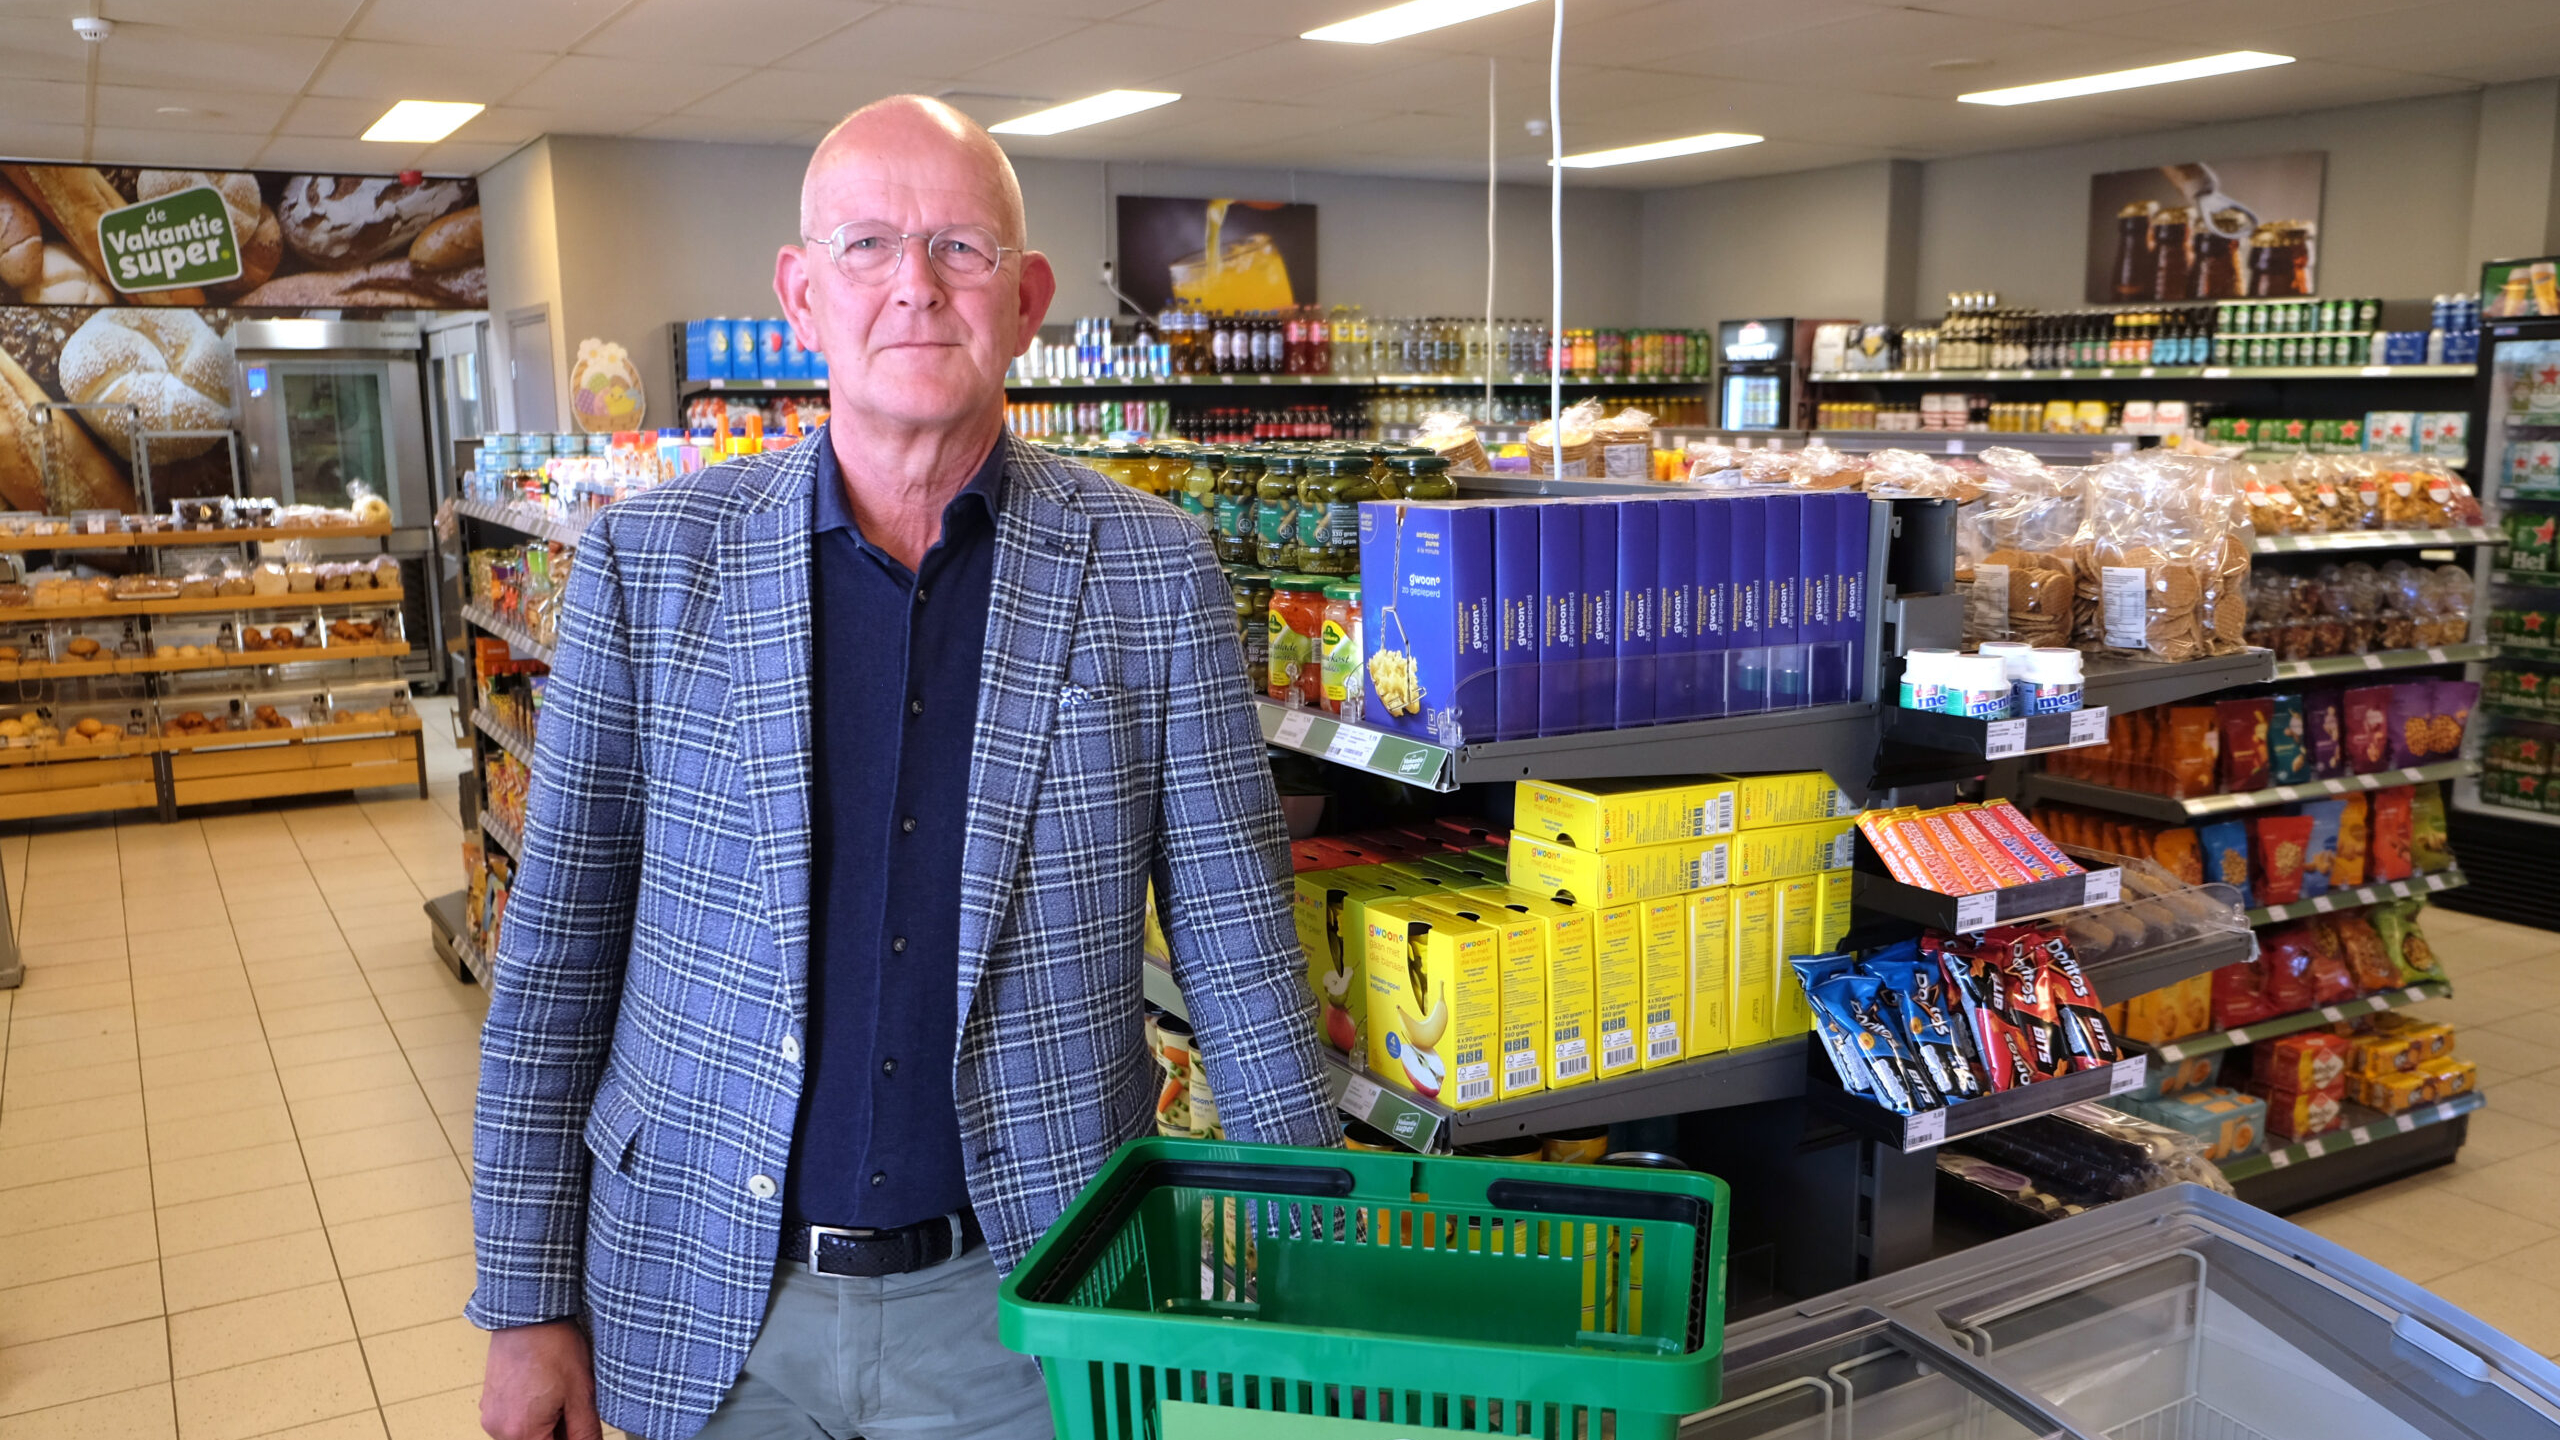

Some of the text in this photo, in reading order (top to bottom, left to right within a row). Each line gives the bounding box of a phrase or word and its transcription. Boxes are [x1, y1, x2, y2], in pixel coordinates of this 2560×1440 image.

[146, 207, 167, 224] de
[106, 213, 224, 254] Vakantie
[1409, 573, 1440, 586] gwoon
[1410, 588, 1440, 598] gepieperd
[1674, 591, 1682, 633] gwoon
[1709, 589, 1717, 631] gwoon
[1780, 583, 1788, 624] gwoon
[1815, 580, 1823, 621] gwoon
[1848, 577, 1856, 618] gwoon
[1472, 604, 1482, 649] gwoon
[1518, 601, 1526, 646] gwoon
[1559, 598, 1568, 643] gwoon
[1595, 596, 1604, 640] gwoon
[1637, 594, 1645, 637] gwoon
[1401, 763, 1421, 773] super
[1534, 791, 1561, 804] gwoon
[1925, 817, 1954, 852] CHOCO
[1948, 813, 1977, 844] CHOCO
[1970, 810, 2001, 838] CHOCO
[1997, 804, 2028, 833] CHOCO
[1532, 847, 1560, 860] gwoon
[1864, 821, 1887, 853] TONY'S
[1883, 827, 1908, 859] TONY'S
[1898, 822, 1926, 857] CHOCO
[1651, 903, 1678, 916] gwoon
[1700, 893, 1727, 905] gwoon
[1556, 917, 1584, 931] gwoon
[1603, 910, 1630, 923] gwoon
[1369, 924, 1403, 943] gwoon
[1460, 938, 1490, 951] gwoon
[1507, 927, 1536, 940] gwoon
[2012, 943, 2037, 1005] Doritos
[2047, 938, 2088, 998] Doritos
[1390, 1036, 1396, 1046] 4
[1851, 1000, 1900, 1049] Doritos
[2090, 1018, 2112, 1052] BITS
[2005, 1032, 2031, 1086] oritos
[2033, 1026, 2052, 1066] BITS
[1907, 1068, 1935, 1107] BITS
[1395, 1124, 1414, 1134] super
